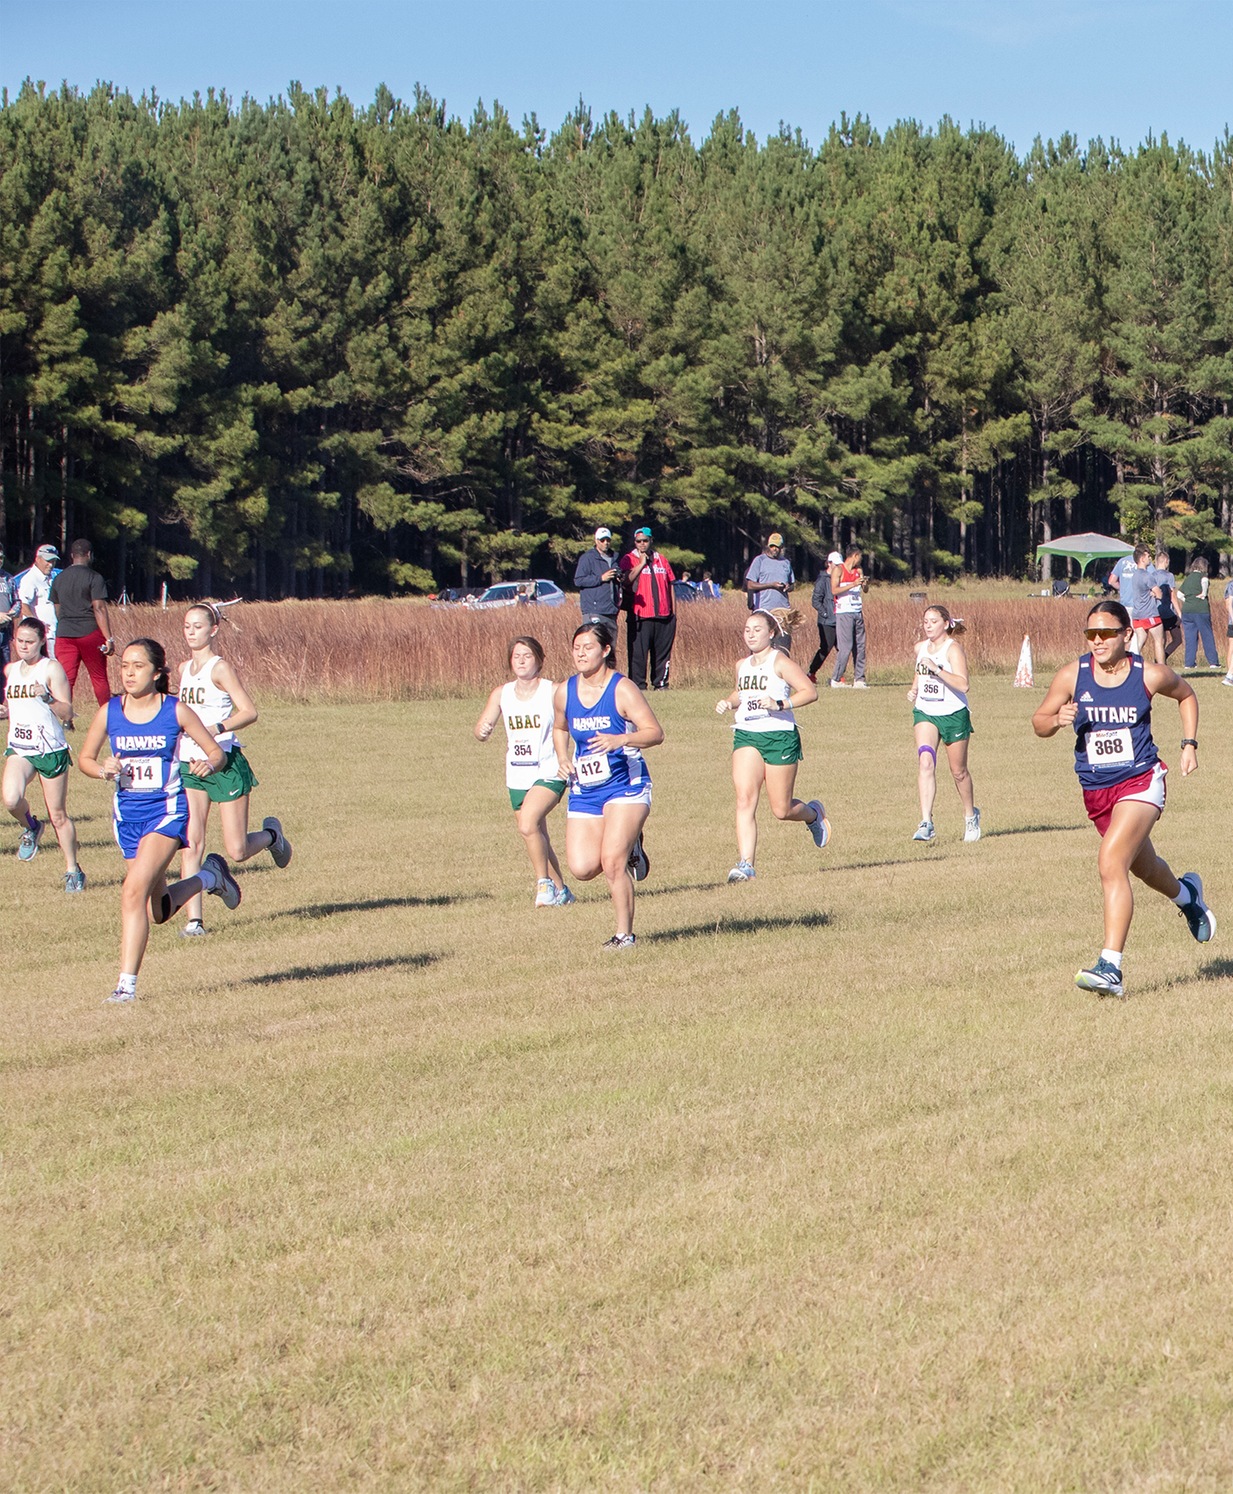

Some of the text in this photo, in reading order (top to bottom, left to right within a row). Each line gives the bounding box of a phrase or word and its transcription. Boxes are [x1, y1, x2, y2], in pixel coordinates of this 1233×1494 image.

[924, 684, 939, 694] 356
[508, 714, 541, 730] ABAC
[1085, 707, 1137, 723] TITANS
[573, 716, 611, 731] HAWKS
[15, 727, 33, 740] 353
[115, 735, 166, 750] HAWKS
[514, 744, 532, 755] 354
[1095, 738, 1123, 755] 368
[127, 765, 153, 780] 414
[581, 761, 603, 776] 412
